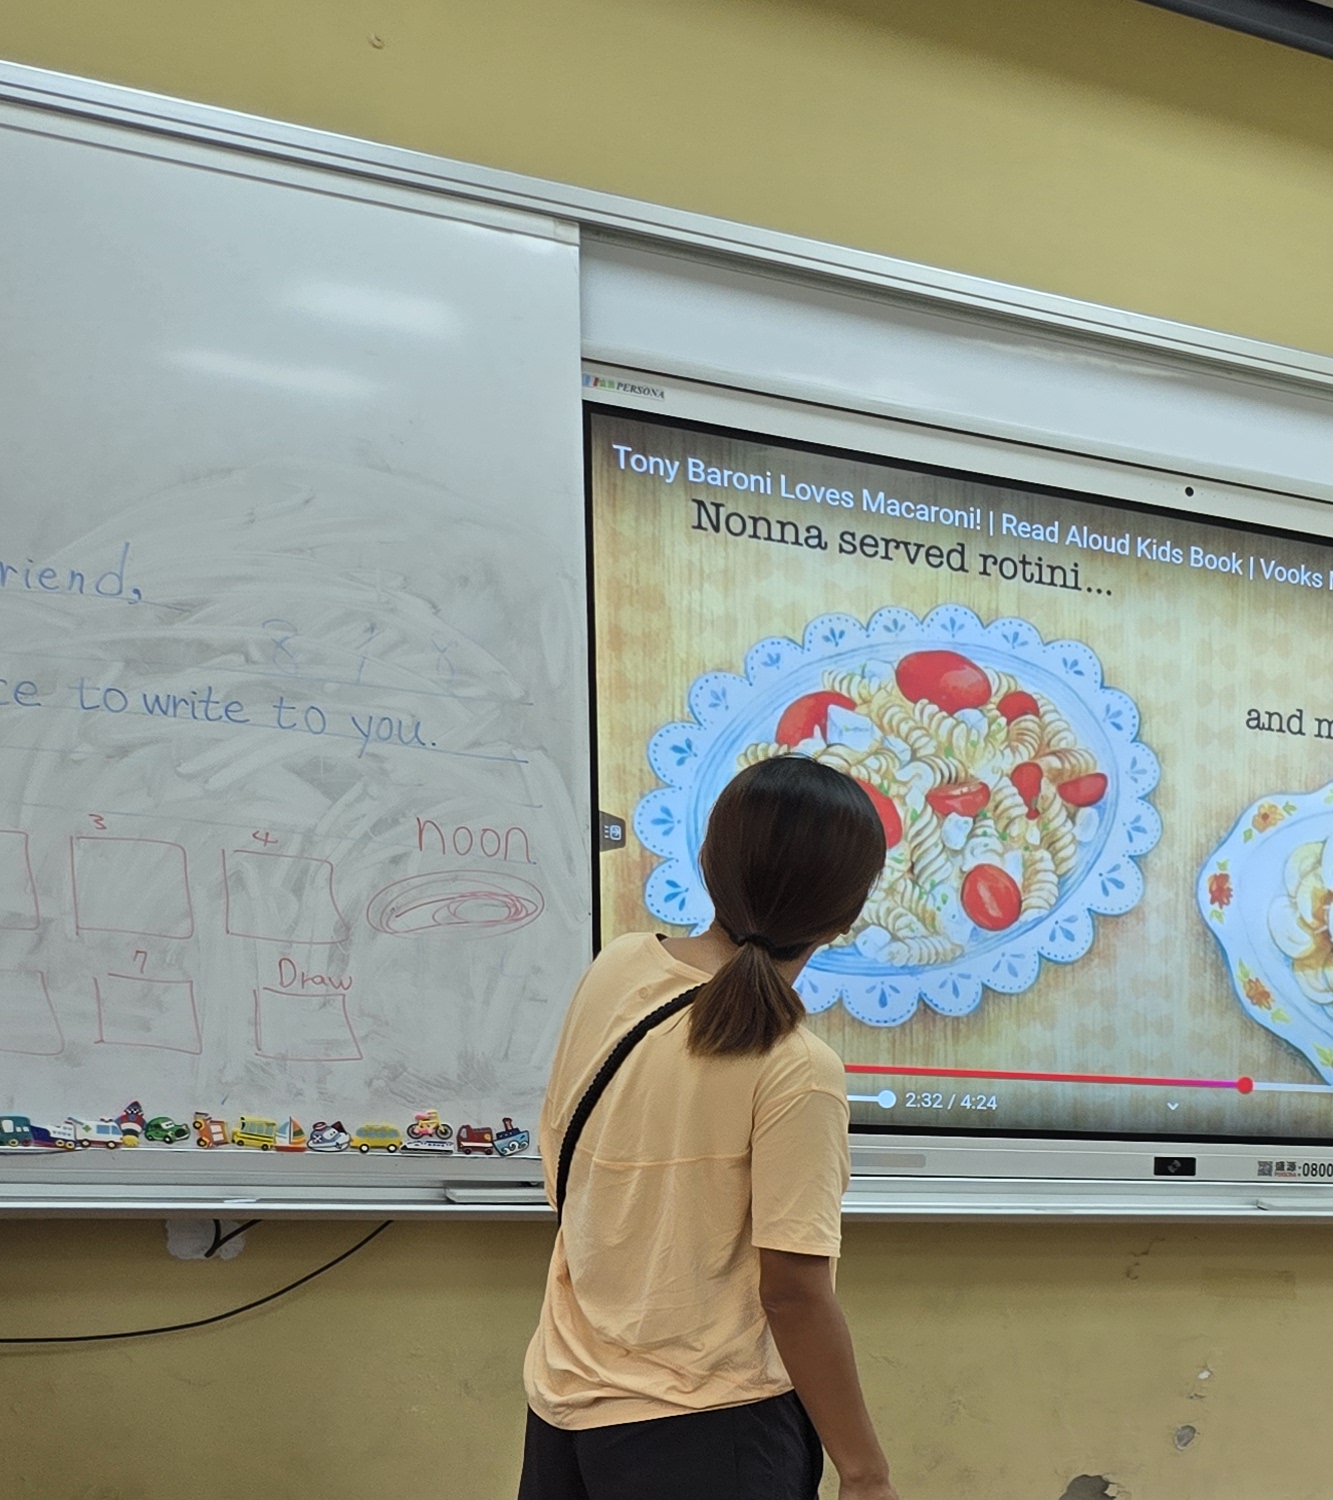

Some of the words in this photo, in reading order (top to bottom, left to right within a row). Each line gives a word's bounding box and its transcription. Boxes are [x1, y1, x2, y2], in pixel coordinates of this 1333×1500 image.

[616, 382, 665, 399] PERSONA
[612, 444, 680, 483] Tony
[688, 458, 772, 495] Baroni
[780, 475, 854, 508] Loves
[862, 488, 981, 530] Macaroni!
[1002, 514, 1059, 543] Read
[1065, 525, 1130, 556] Aloud
[1137, 537, 1183, 564] Kids
[1190, 546, 1243, 575] Book
[1260, 558, 1323, 589] Vooks
[691, 498, 828, 550] Nonna
[838, 530, 969, 574] served
[978, 552, 1112, 596] rotini...
[68, 677, 128, 713] to
[143, 685, 250, 723] write
[273, 696, 326, 735] to
[351, 715, 437, 759] you.
[1245, 708, 1305, 736] and
[88, 813, 107, 830] 3
[252, 830, 278, 846] 4
[416, 817, 532, 864] noon
[132, 950, 148, 974] 7
[278, 957, 352, 990] Draw
[905, 1092, 943, 1108] 2:32
[960, 1094, 998, 1110] 4:24
